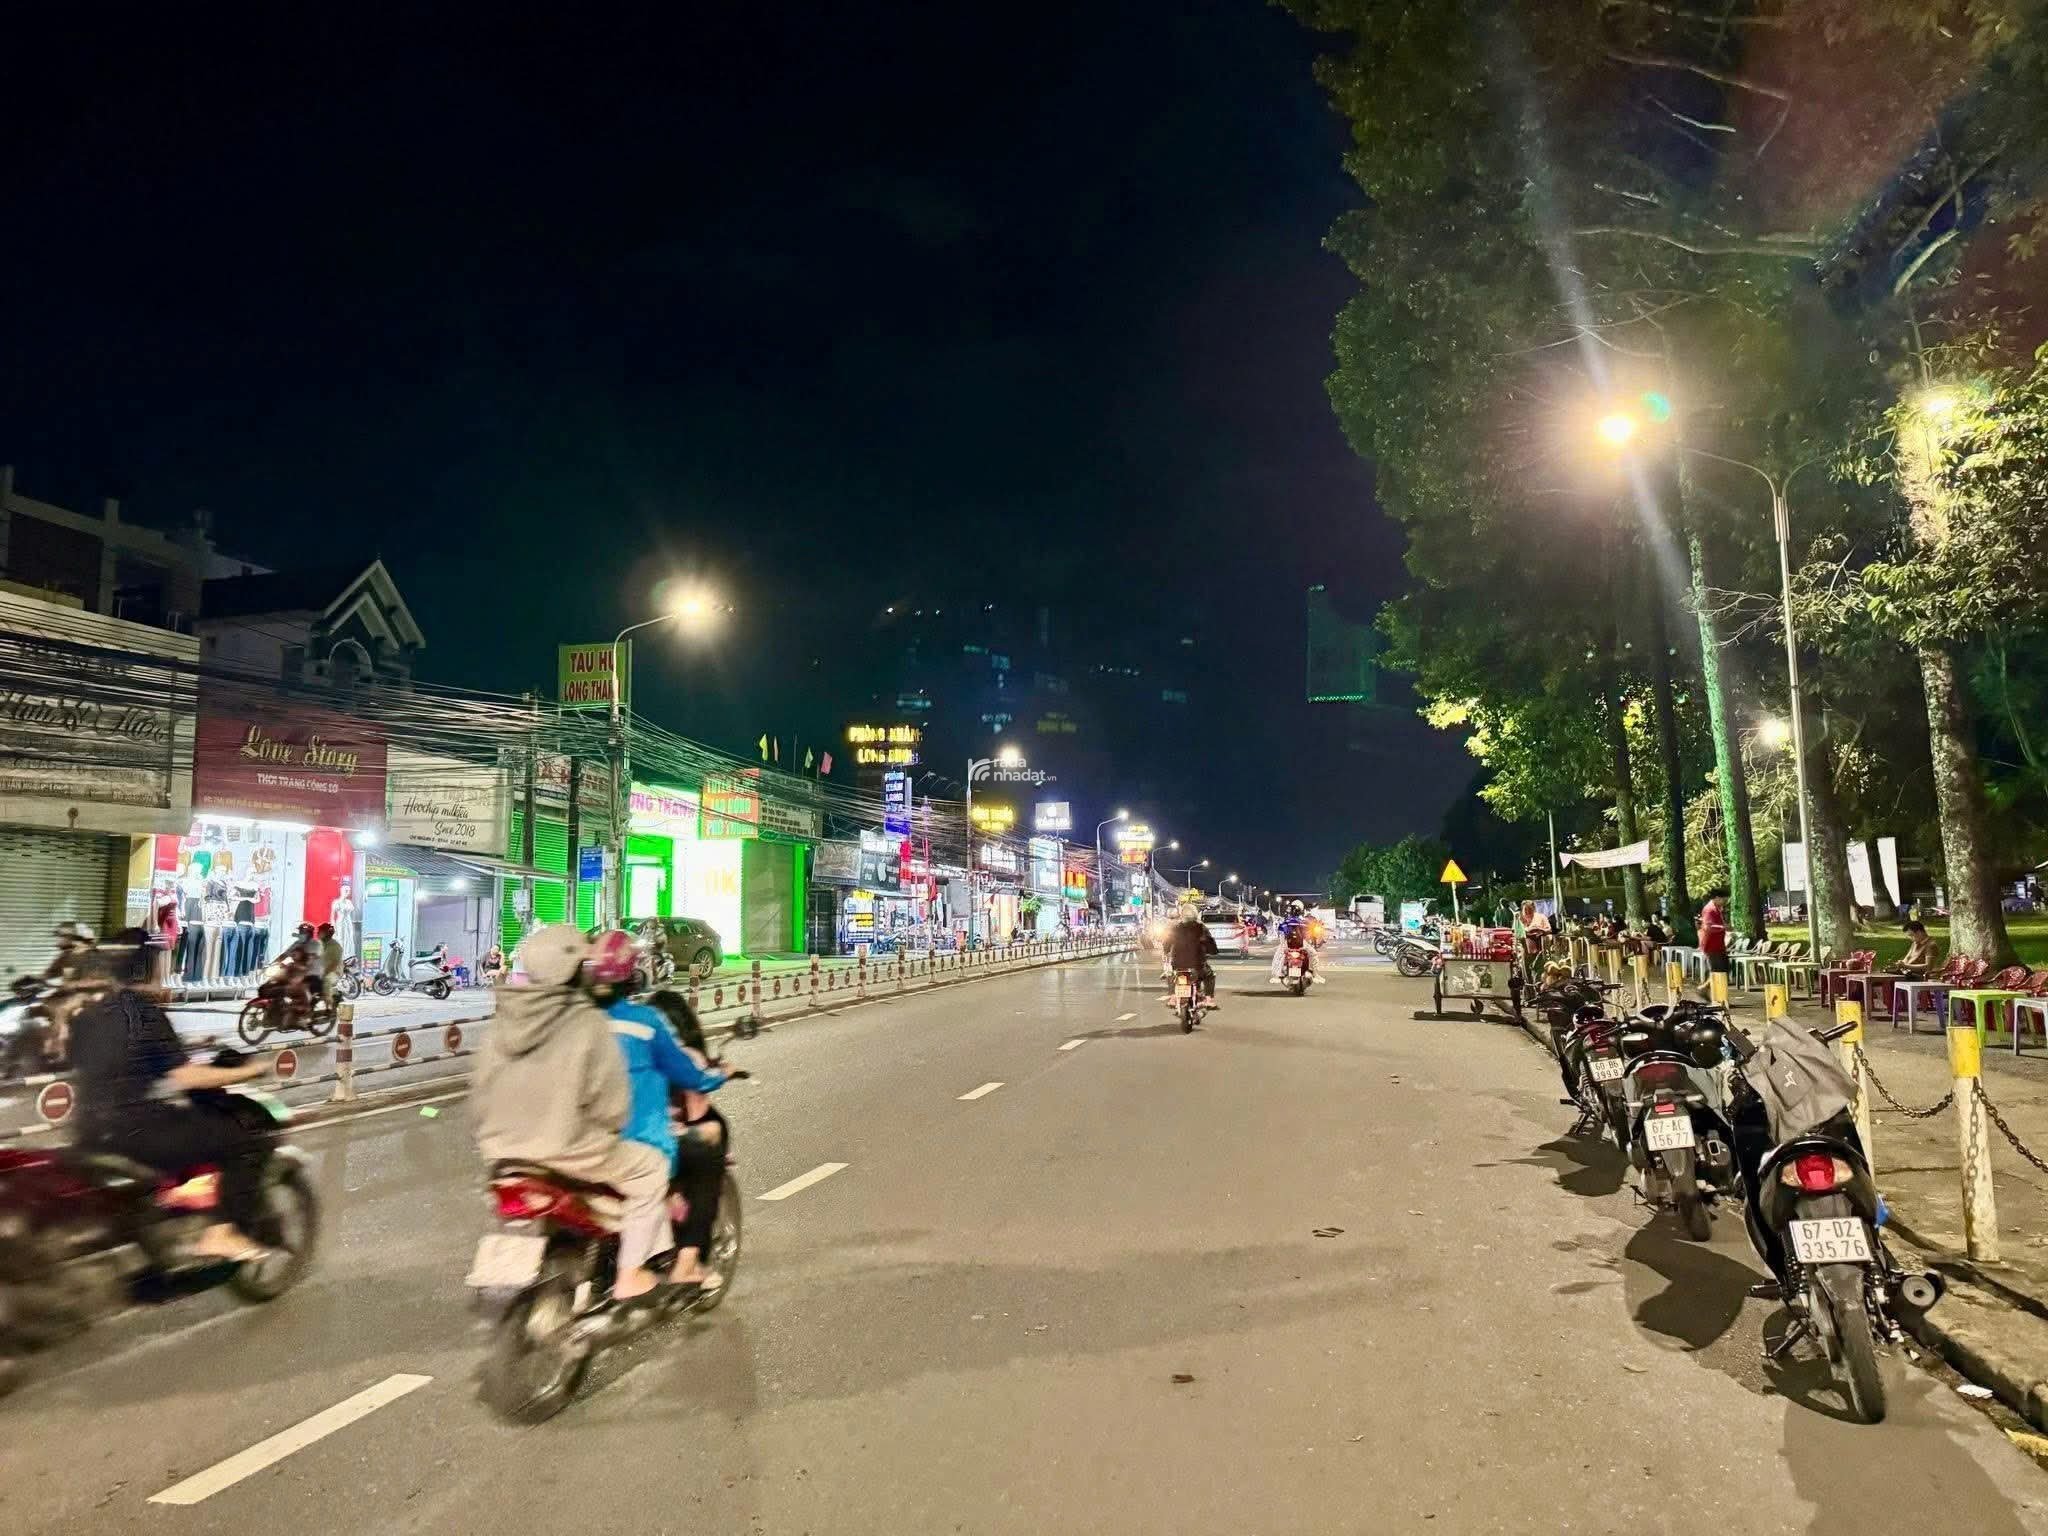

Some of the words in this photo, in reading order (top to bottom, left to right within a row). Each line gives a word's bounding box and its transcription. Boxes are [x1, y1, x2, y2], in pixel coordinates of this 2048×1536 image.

[564, 680, 588, 702] LONG
[240, 724, 294, 765] Love
[302, 735, 360, 778] Story
[454, 824, 476, 838] 2018
